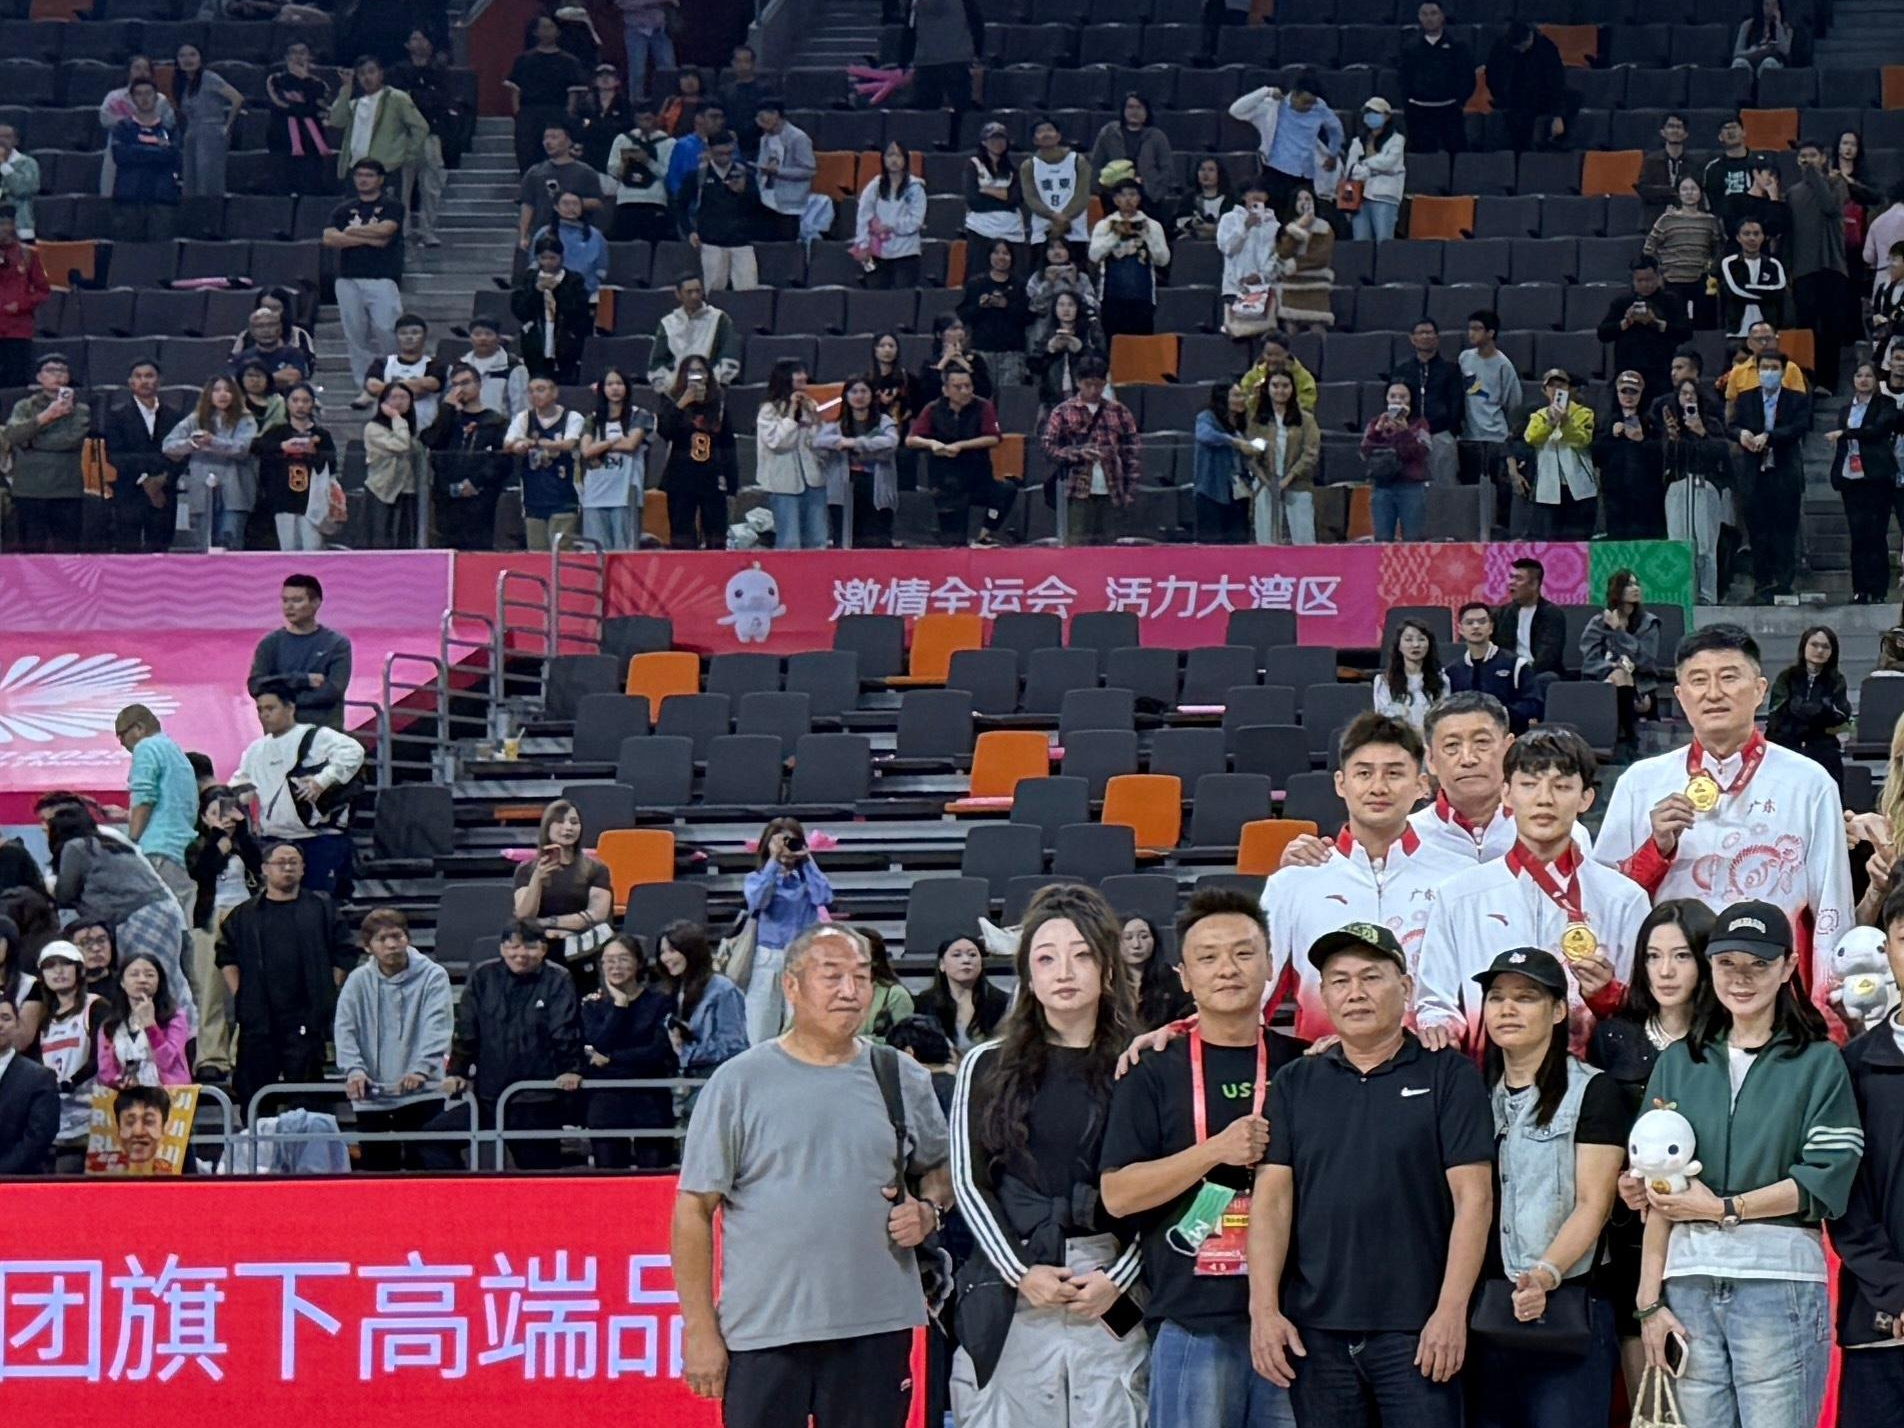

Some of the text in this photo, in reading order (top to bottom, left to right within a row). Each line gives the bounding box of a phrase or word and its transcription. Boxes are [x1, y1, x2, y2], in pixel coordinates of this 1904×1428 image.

[832, 575, 1341, 619] 激情全运会 活力大湾区
[0, 1253, 684, 1383] 团旗下高端品
